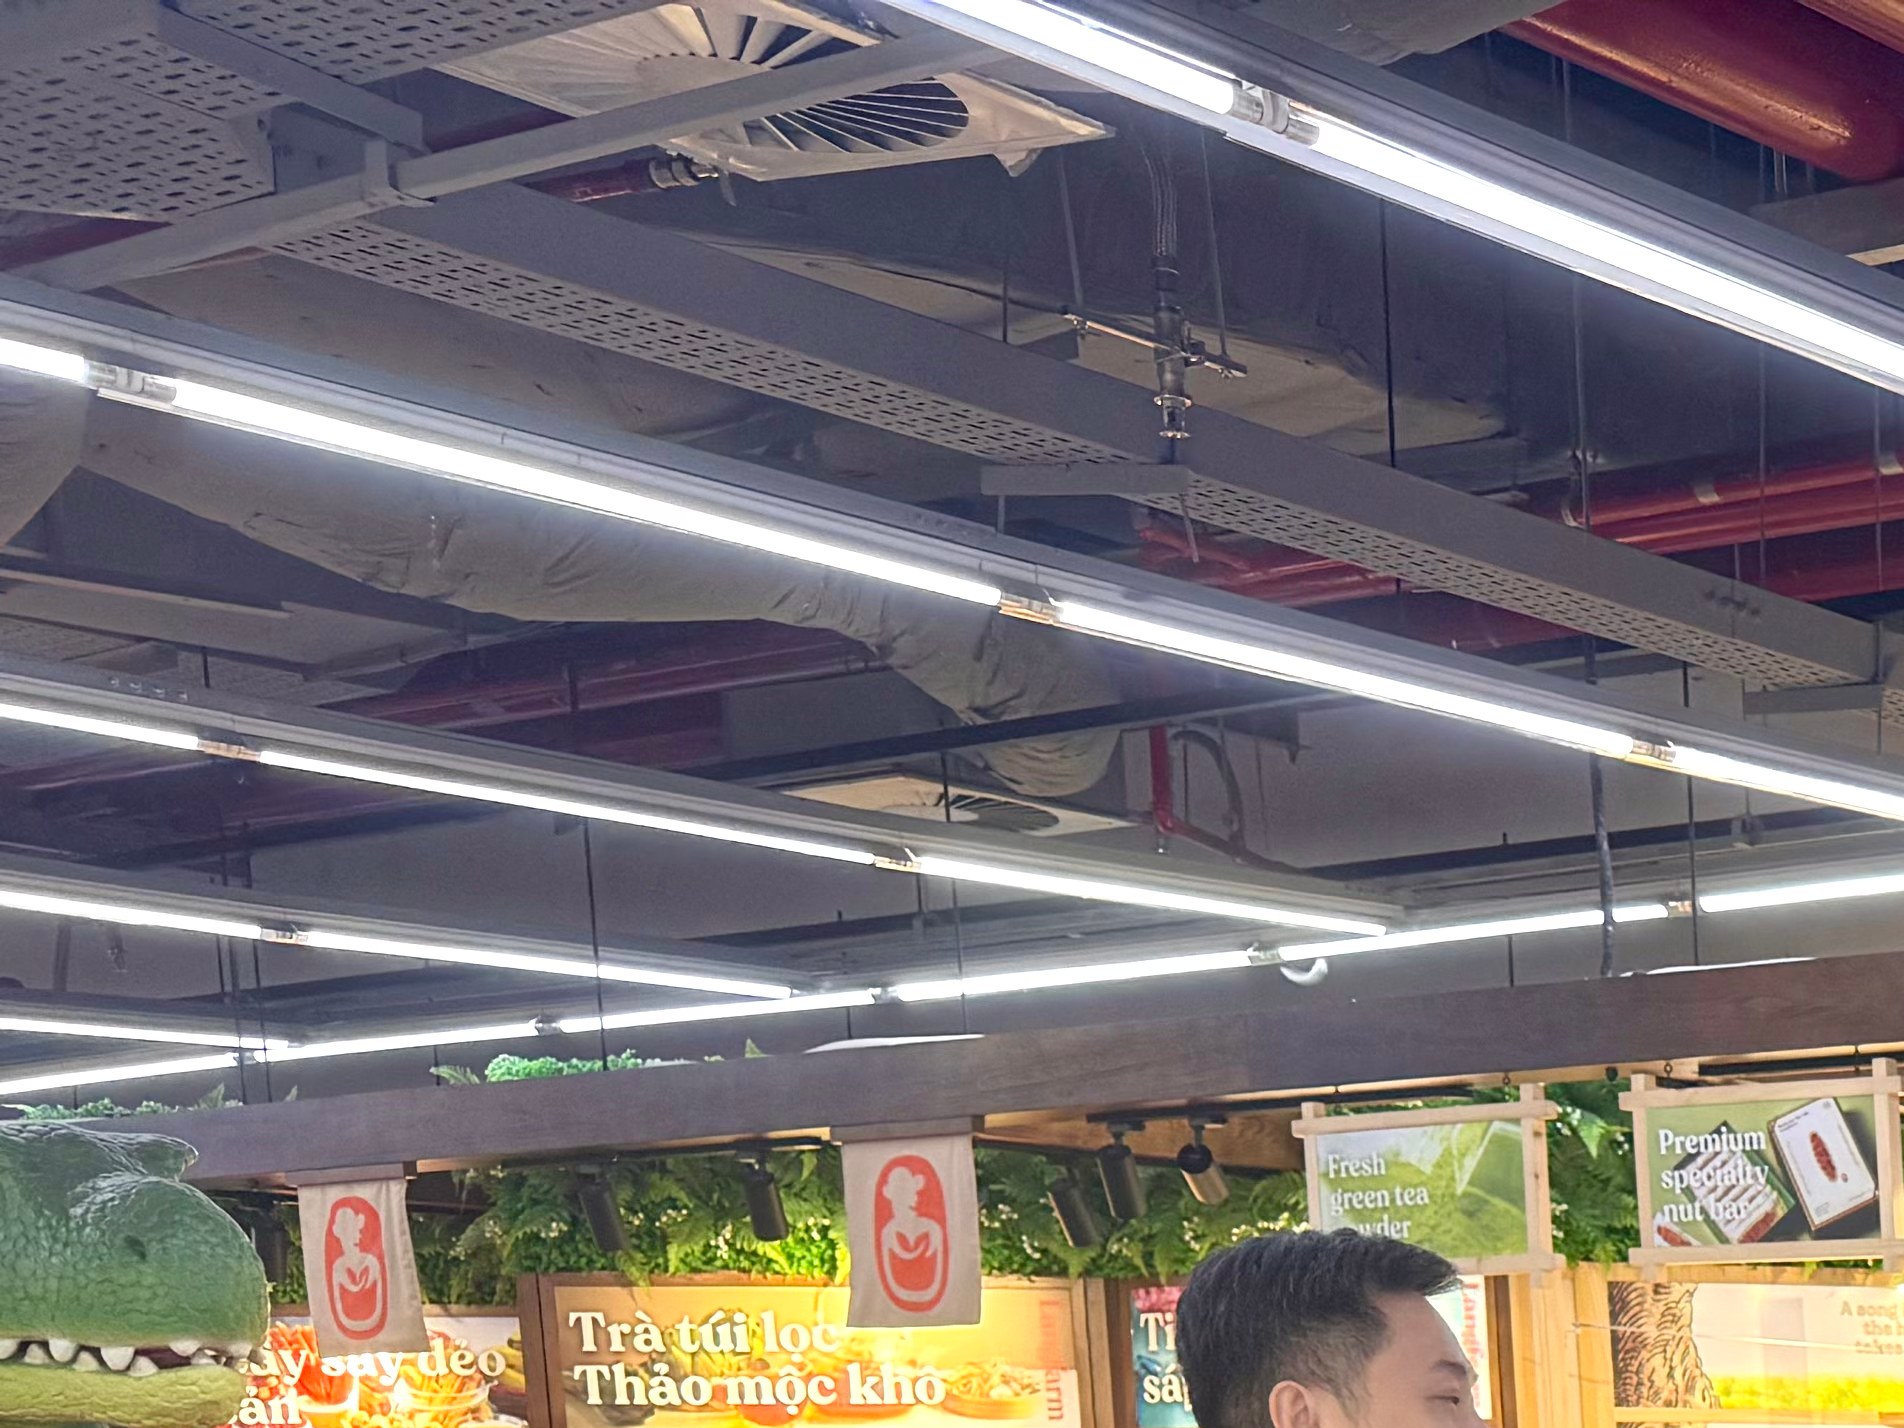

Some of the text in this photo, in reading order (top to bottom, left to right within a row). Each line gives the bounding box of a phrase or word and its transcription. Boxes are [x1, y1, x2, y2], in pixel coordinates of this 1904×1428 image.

[1658, 1128, 1767, 1154] Premium
[1327, 1152, 1386, 1179] Fresh
[1660, 1158, 1769, 1195] specialty
[1330, 1185, 1430, 1216] green tea
[1663, 1197, 1750, 1222] nut bar
[1345, 1214, 1412, 1239] owder
[568, 1309, 841, 1363] Trà túi lọc
[1139, 1311, 1177, 1352] Ti
[416, 1338, 506, 1376] dẻo
[1038, 1299, 1068, 1421] Lanarm
[229, 1386, 302, 1425] ản
[573, 1362, 947, 1415] Thảo mộc khô
